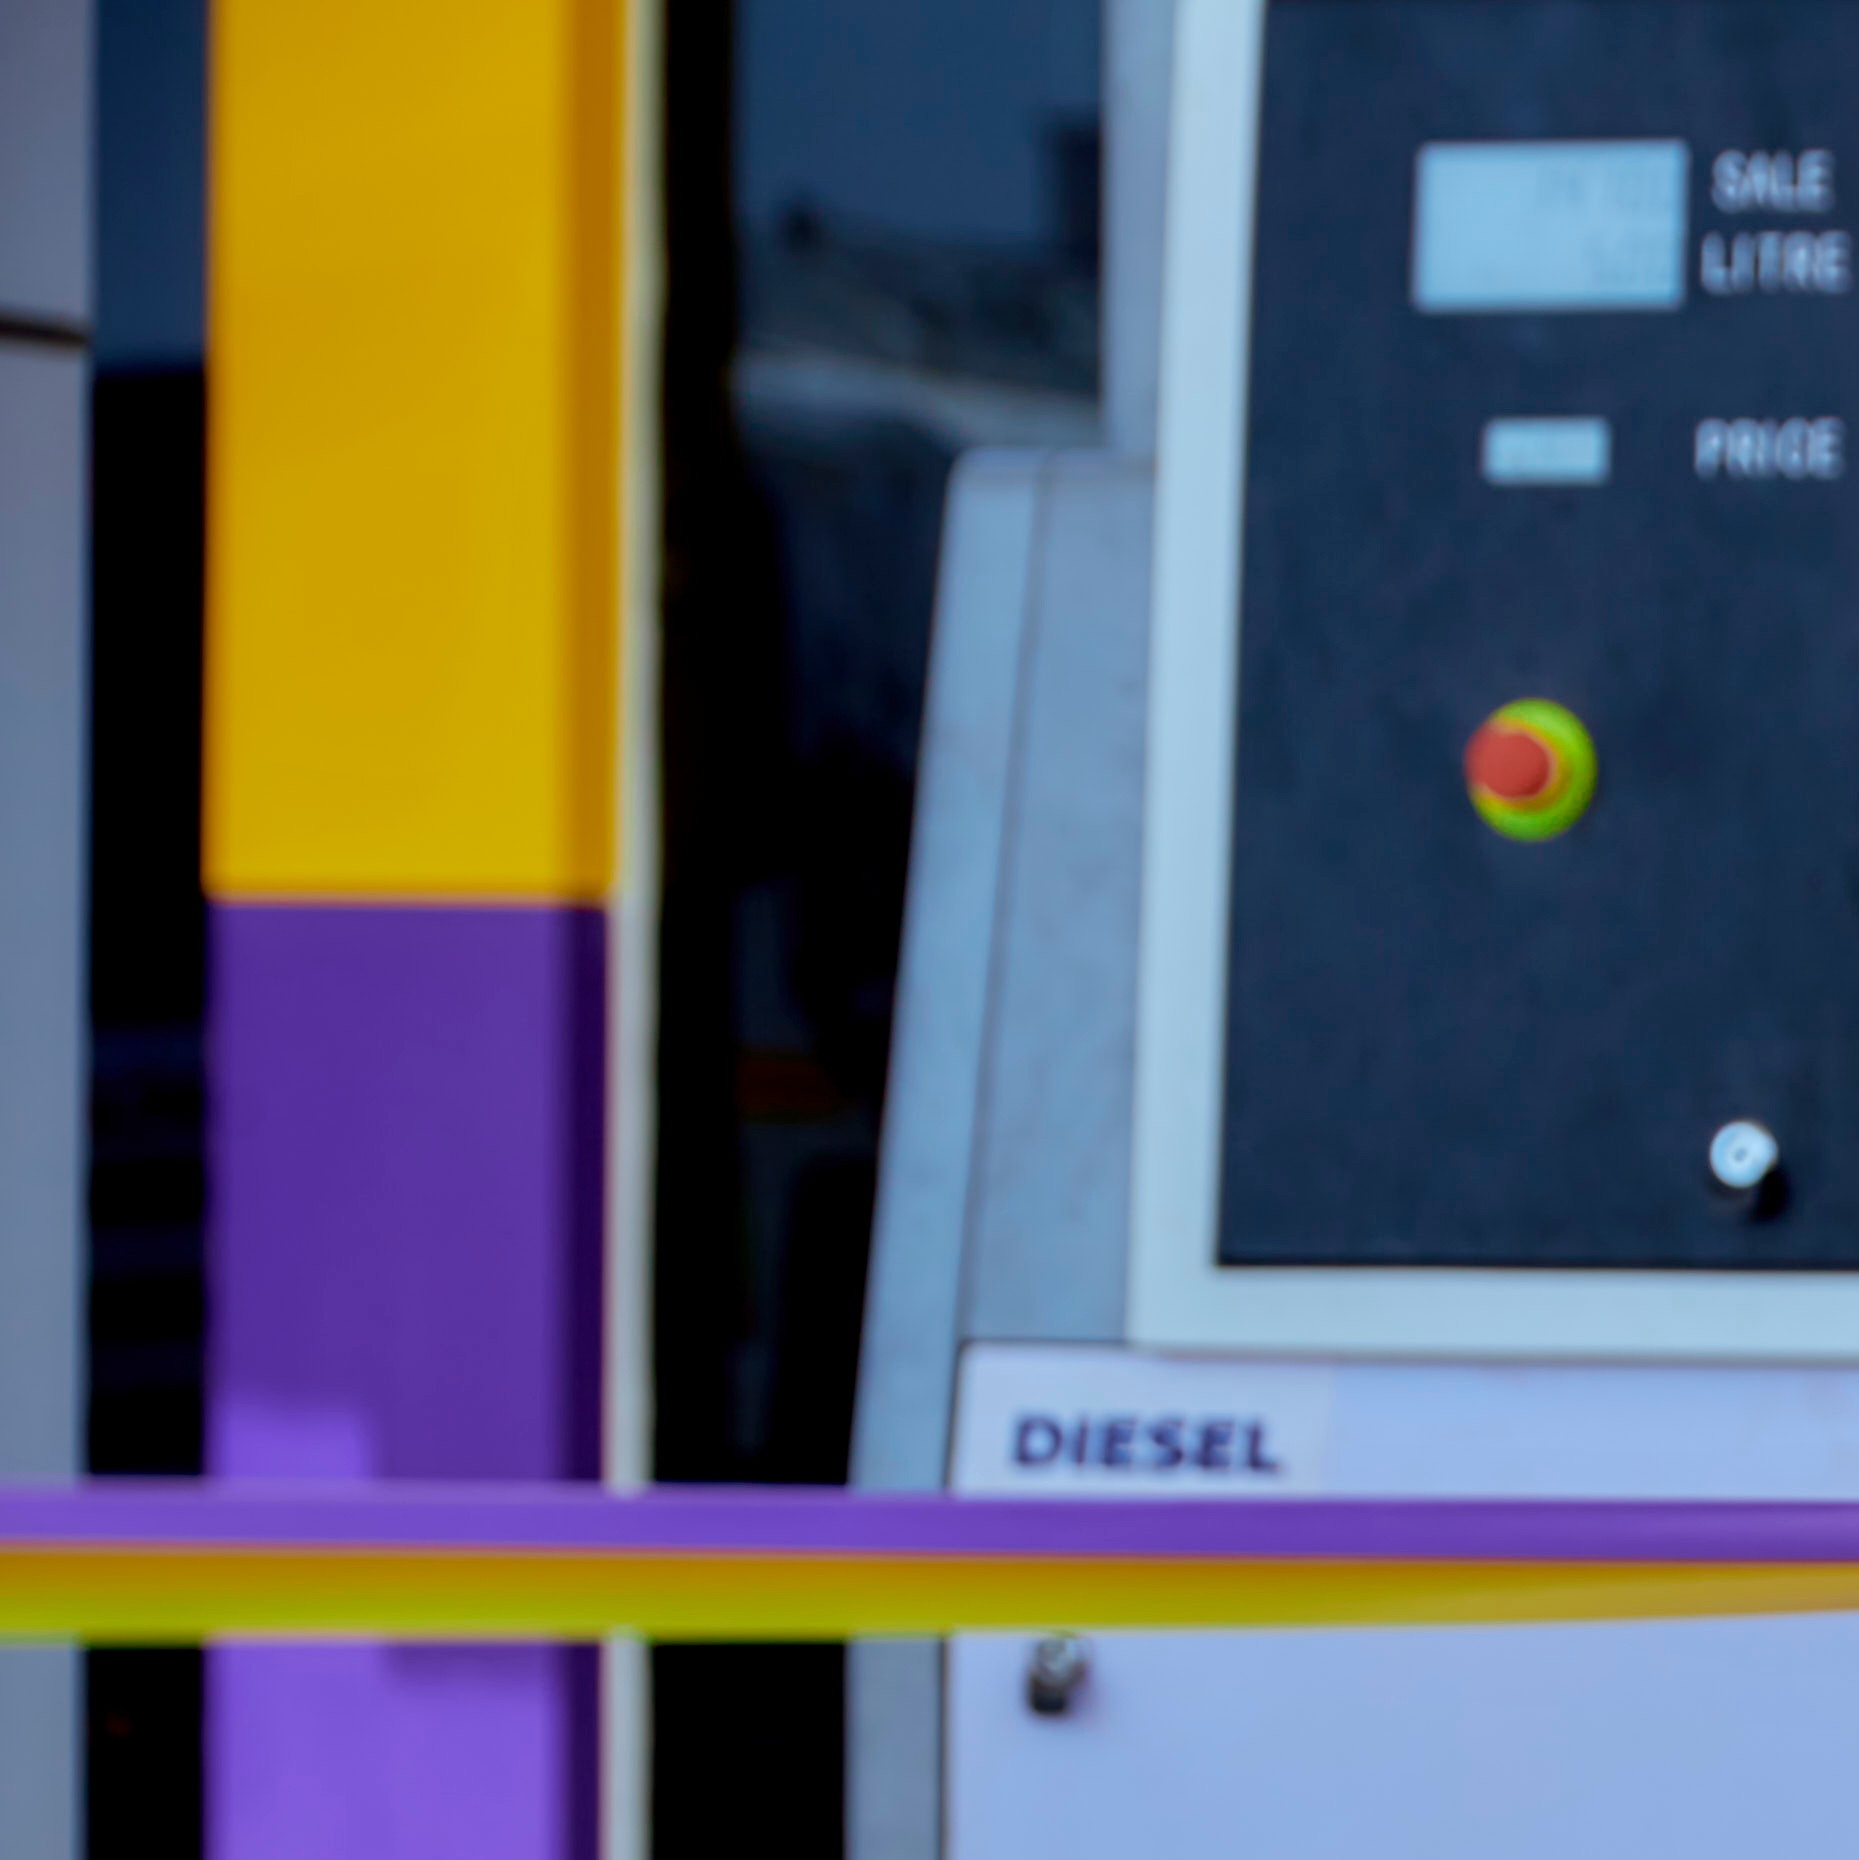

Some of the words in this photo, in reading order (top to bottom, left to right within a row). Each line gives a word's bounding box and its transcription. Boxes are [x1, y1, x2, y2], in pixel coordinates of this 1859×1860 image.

[1711, 150, 1834, 212] SALE
[1700, 231, 1851, 294] LITRE
[1694, 417, 1844, 480] PRICE
[1012, 1415, 1284, 1474] DIESEL
